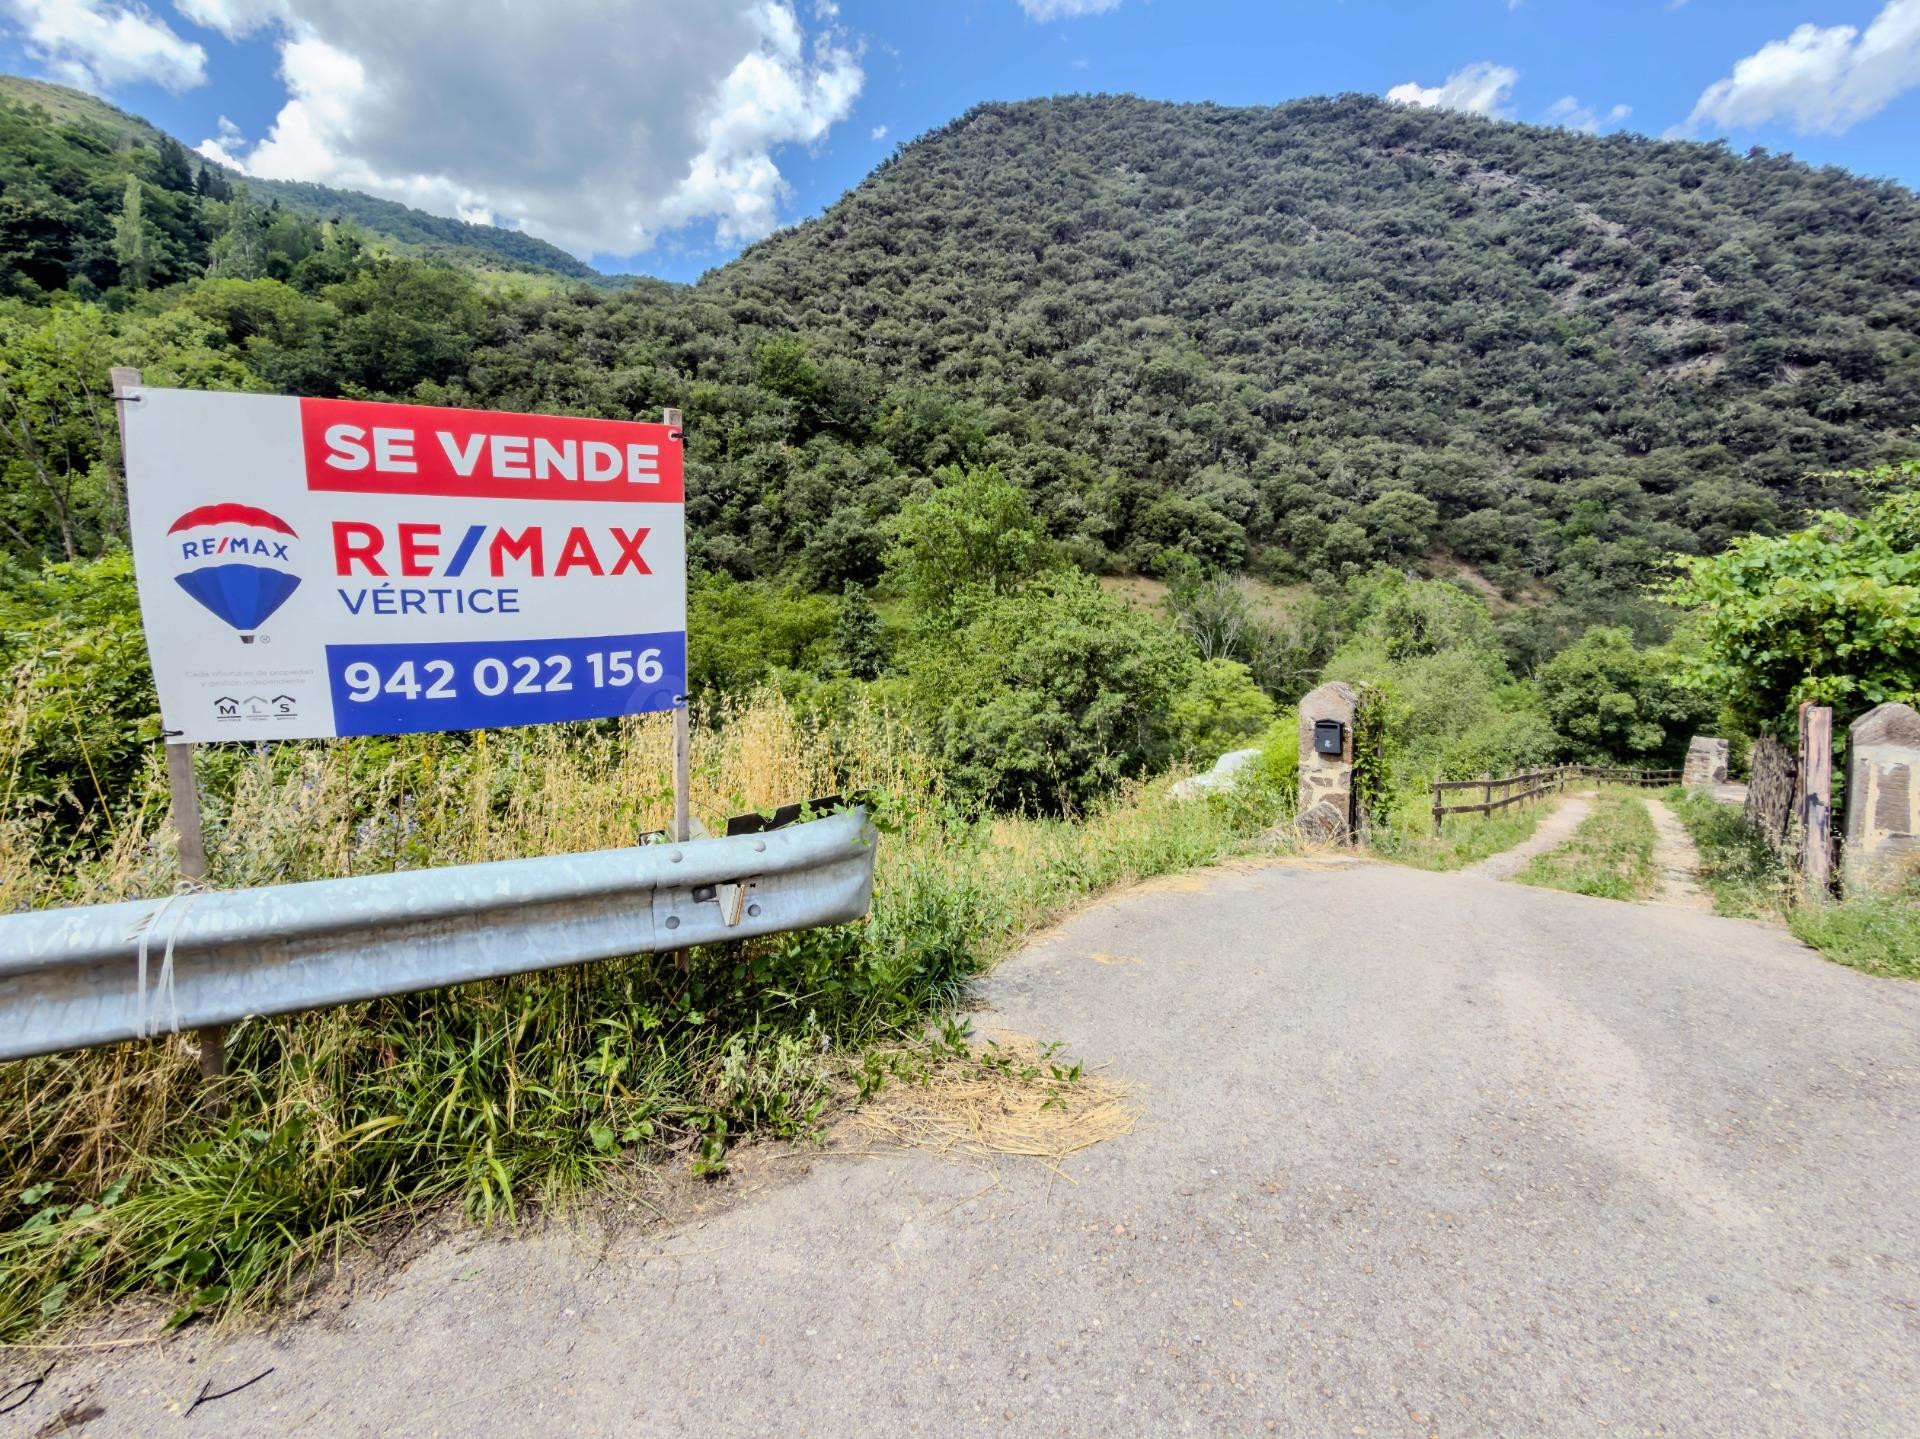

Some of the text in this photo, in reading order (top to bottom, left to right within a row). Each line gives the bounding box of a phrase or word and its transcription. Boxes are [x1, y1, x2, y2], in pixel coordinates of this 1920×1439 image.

[325, 424, 660, 484] SE VENDE
[182, 536, 289, 562] RE/MAX
[332, 521, 652, 577] RE/MAX
[338, 582, 520, 615] VÉRTICE
[343, 648, 664, 702] 942 022 156
[219, 705, 237, 715] M
[279, 703, 290, 713] S
